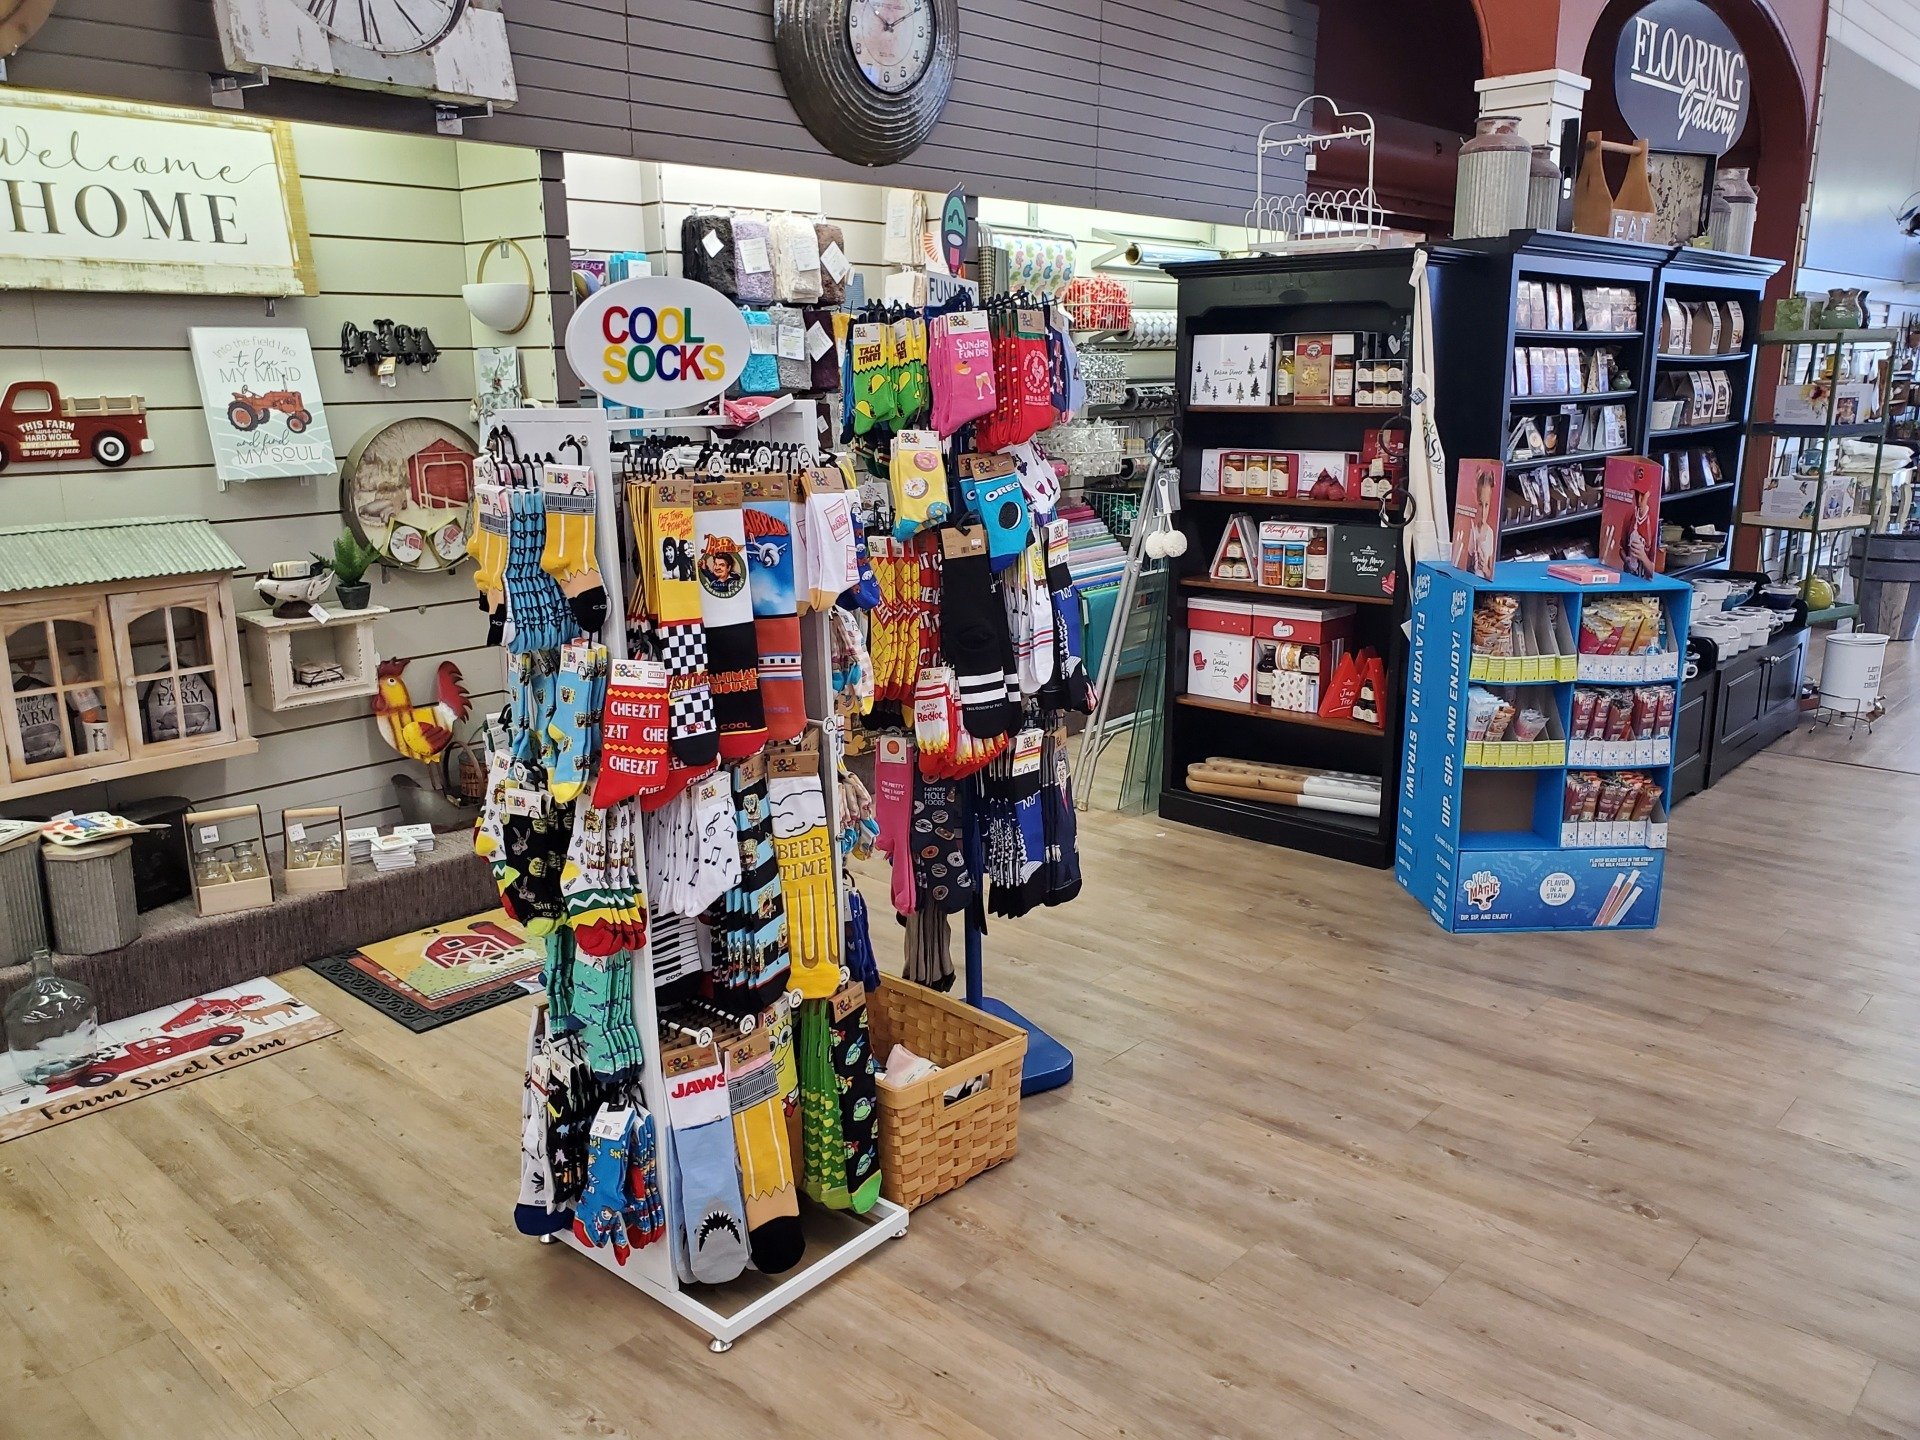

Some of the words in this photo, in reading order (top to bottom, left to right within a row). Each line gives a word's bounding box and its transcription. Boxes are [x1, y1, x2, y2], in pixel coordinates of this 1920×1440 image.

[1631, 16, 1744, 102] FLOORING
[1677, 79, 1737, 150] Gallery
[0, 125, 276, 184] Welcome
[0, 178, 248, 245] HOME
[1614, 215, 1651, 243] EAT
[602, 306, 705, 345] COOL
[213, 343, 232, 359] Into
[233, 338, 250, 348] the
[252, 336, 275, 349] field
[281, 347, 297, 357] go
[254, 347, 279, 371] lose
[602, 344, 726, 385] SOCKS
[220, 368, 247, 383] MY
[255, 367, 302, 382] MIND
[18, 420, 43, 433] THIS
[45, 420, 75, 431] FARM
[25, 434, 47, 442] HARD
[48, 433, 73, 441] WORK
[236, 430, 261, 448] and
[262, 429, 290, 455] find
[236, 448, 264, 465] MY
[271, 446, 321, 463] SOUL
[984, 481, 1020, 502] OREO
[1265, 524, 1286, 538] Bloody
[1287, 524, 1306, 538] Mary
[1352, 556, 1369, 567] Bloody
[1370, 556, 1385, 567] Mary
[1356, 563, 1379, 572] Collection
[1413, 612, 1426, 685] FLAVOR
[1212, 658, 1230, 668] Cocktail
[1214, 665, 1227, 675] Party
[1449, 631, 1461, 701] ENJOY!
[708, 667, 759, 684] ANIMAL
[711, 679, 758, 694] HOUSE
[1411, 688, 1420, 708] IN
[19, 708, 55, 727] ARM
[720, 722, 751, 730] COOL
[1410, 711, 1419, 724] A
[1446, 705, 1457, 746] AND
[1405, 730, 1418, 799] STRAW!
[924, 791, 946, 800] HOLE
[777, 836, 825, 861] BEER
[779, 856, 828, 882] TIME
[1472, 872, 1492, 887] Milk
[1546, 879, 1570, 887] FLAVOR
[1469, 882, 1499, 900] MAGIC
[665, 971, 684, 981] COOL
[667, 1055, 694, 1067] COOL
[669, 1060, 699, 1073] SOCKS
[39, 1089, 128, 1121] Farm
[130, 1060, 208, 1091] Sweet
[210, 1036, 286, 1066] Farm
[671, 1073, 726, 1099] JAWS
